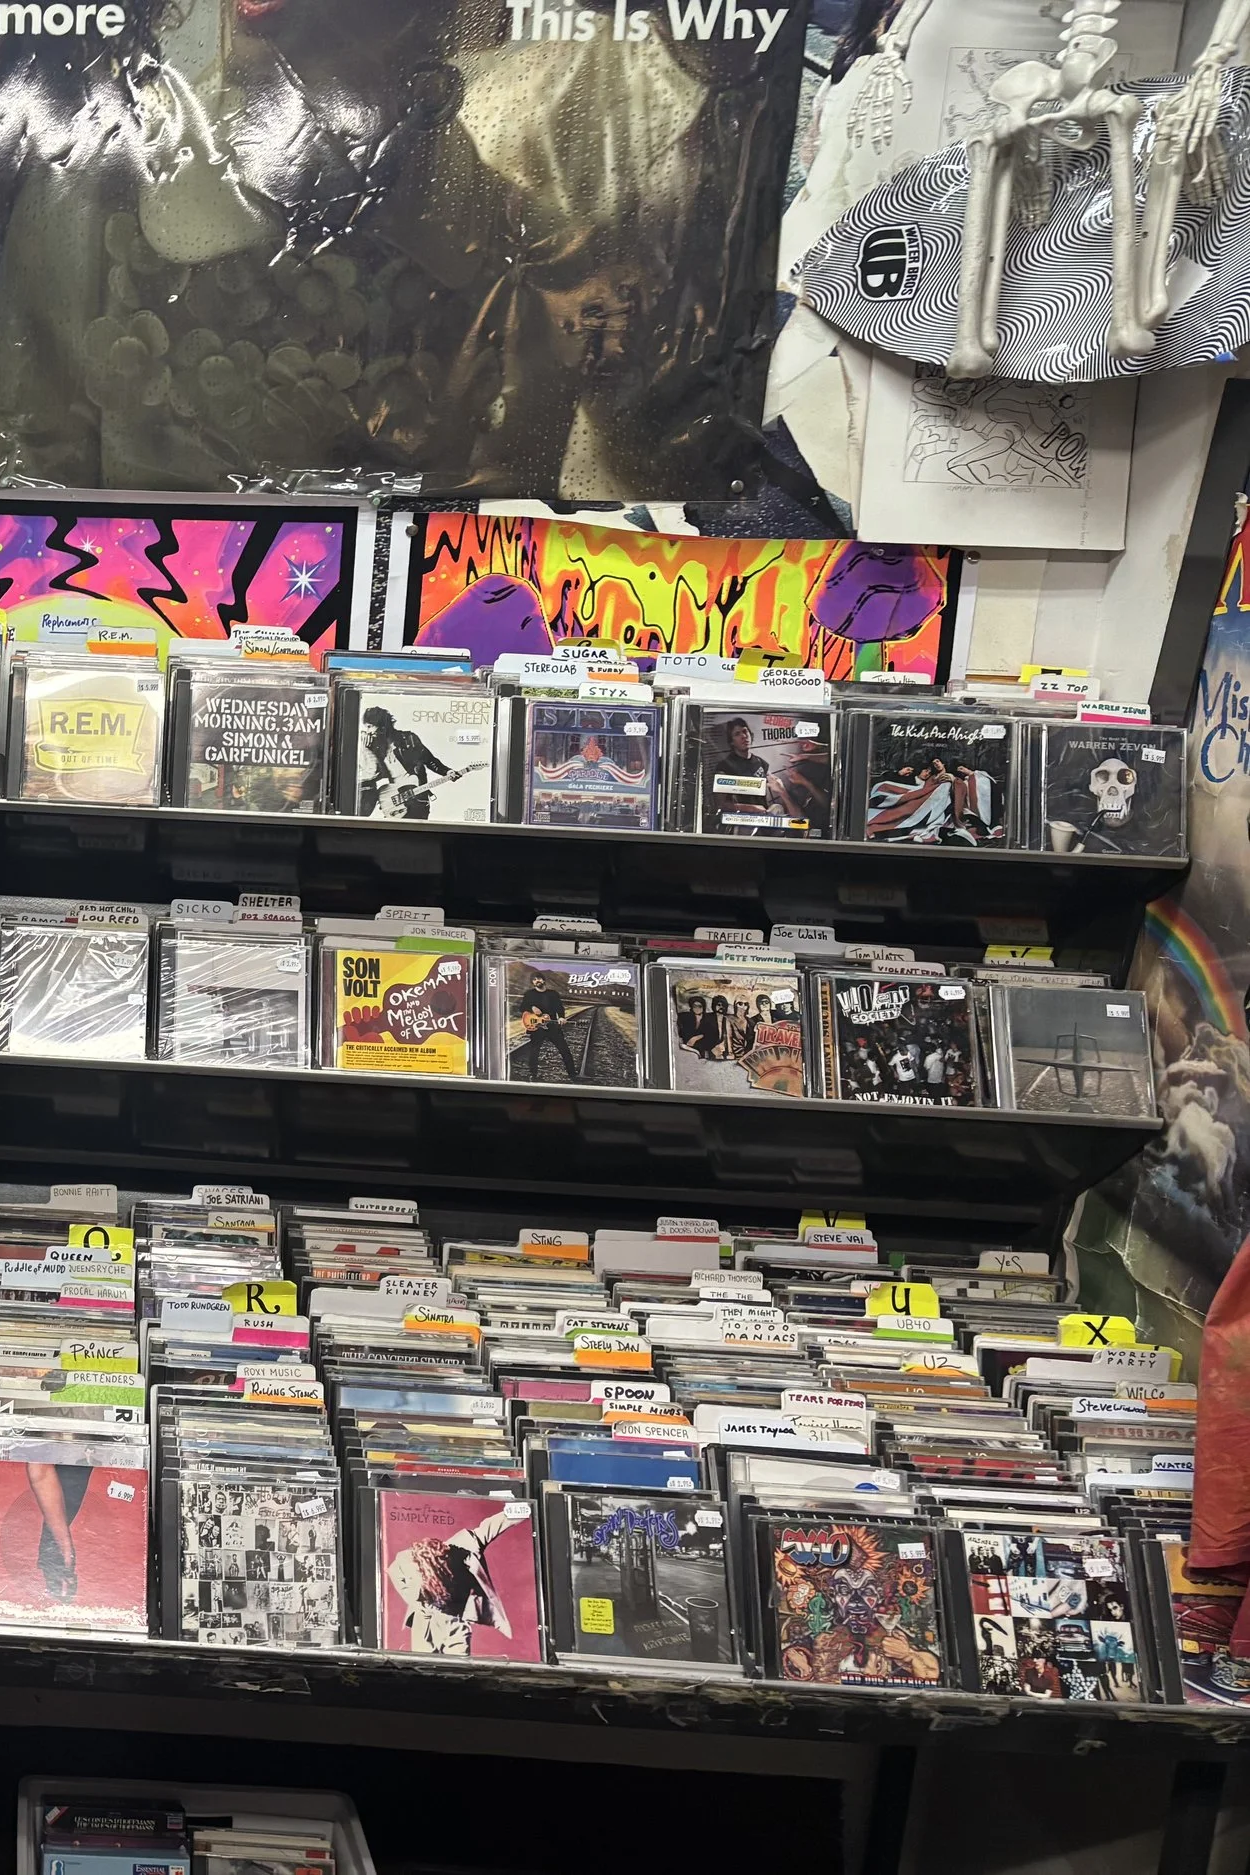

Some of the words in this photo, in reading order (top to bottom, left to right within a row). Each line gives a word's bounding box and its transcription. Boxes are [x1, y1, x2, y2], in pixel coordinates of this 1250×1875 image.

[507, 0, 596, 41] This
[613, 0, 650, 41] Is
[670, 0, 789, 54] Why
[904, 226, 921, 264] WATER
[900, 266, 920, 296] BROS
[560, 647, 608, 661] SUGAR
[661, 655, 707, 667] TOTO
[523, 662, 577, 676] STEREOLAB
[762, 668, 806, 678] GEORGE
[759, 677, 821, 688] THOROGOOD
[588, 685, 628, 697] STYX
[205, 697, 310, 717] WEDNESDAY
[449, 700, 492, 714] BRUCE
[49, 711, 133, 737] R.E.M.
[194, 713, 281, 732] MORNING,
[283, 716, 322, 734] 3AM
[411, 710, 489, 725] SPRINGSTEEN
[222, 733, 274, 749] SIMON
[277, 733, 294, 750] &
[95, 755, 119, 764] TIME
[204, 746, 310, 766] GARFUNKEL
[176, 902, 222, 916] SICKO
[241, 895, 294, 909] SHELTER
[81, 913, 105, 924] LOU
[106, 914, 140, 925] REED
[410, 927, 428, 937] JON
[430, 928, 468, 940] SPENCER
[705, 929, 754, 942] TRAFFIC
[342, 956, 381, 979] SON
[488, 967, 497, 988] ICON
[342, 977, 381, 999] VOLT
[850, 1008, 900, 1024] SOCIETY
[399, 1028, 412, 1040] OF
[412, 1011, 465, 1039] RIOT
[345, 1043, 356, 1053] THE
[356, 1044, 384, 1054] CRITICALLY
[407, 1046, 418, 1056] NEW
[418, 1046, 438, 1056] ALBUM
[206, 1193, 222, 1207] JOE
[225, 1193, 264, 1206] SATRIANI
[812, 1233, 845, 1244] STEVE
[850, 1233, 865, 1245] VAI
[385, 1280, 439, 1290] SLEATER
[246, 1283, 281, 1316] R
[385, 1289, 438, 1298] KINNEY
[166, 1301, 189, 1311] TODD
[190, 1301, 230, 1313] RUNDGREN
[244, 1318, 274, 1329] RUSH
[566, 1318, 588, 1328] CAT
[590, 1320, 630, 1332] STEVENS
[896, 1319, 931, 1331] UB40
[1082, 1316, 1111, 1346] X
[923, 1355, 960, 1371] U2
[72, 1372, 136, 1386] PRETENDERS
[603, 1386, 655, 1401] SPOON
[621, 1425, 639, 1435] JON
[644, 1426, 689, 1439] SPENCER
[389, 1512, 429, 1524] SIMPLY
[431, 1513, 456, 1526] RED
